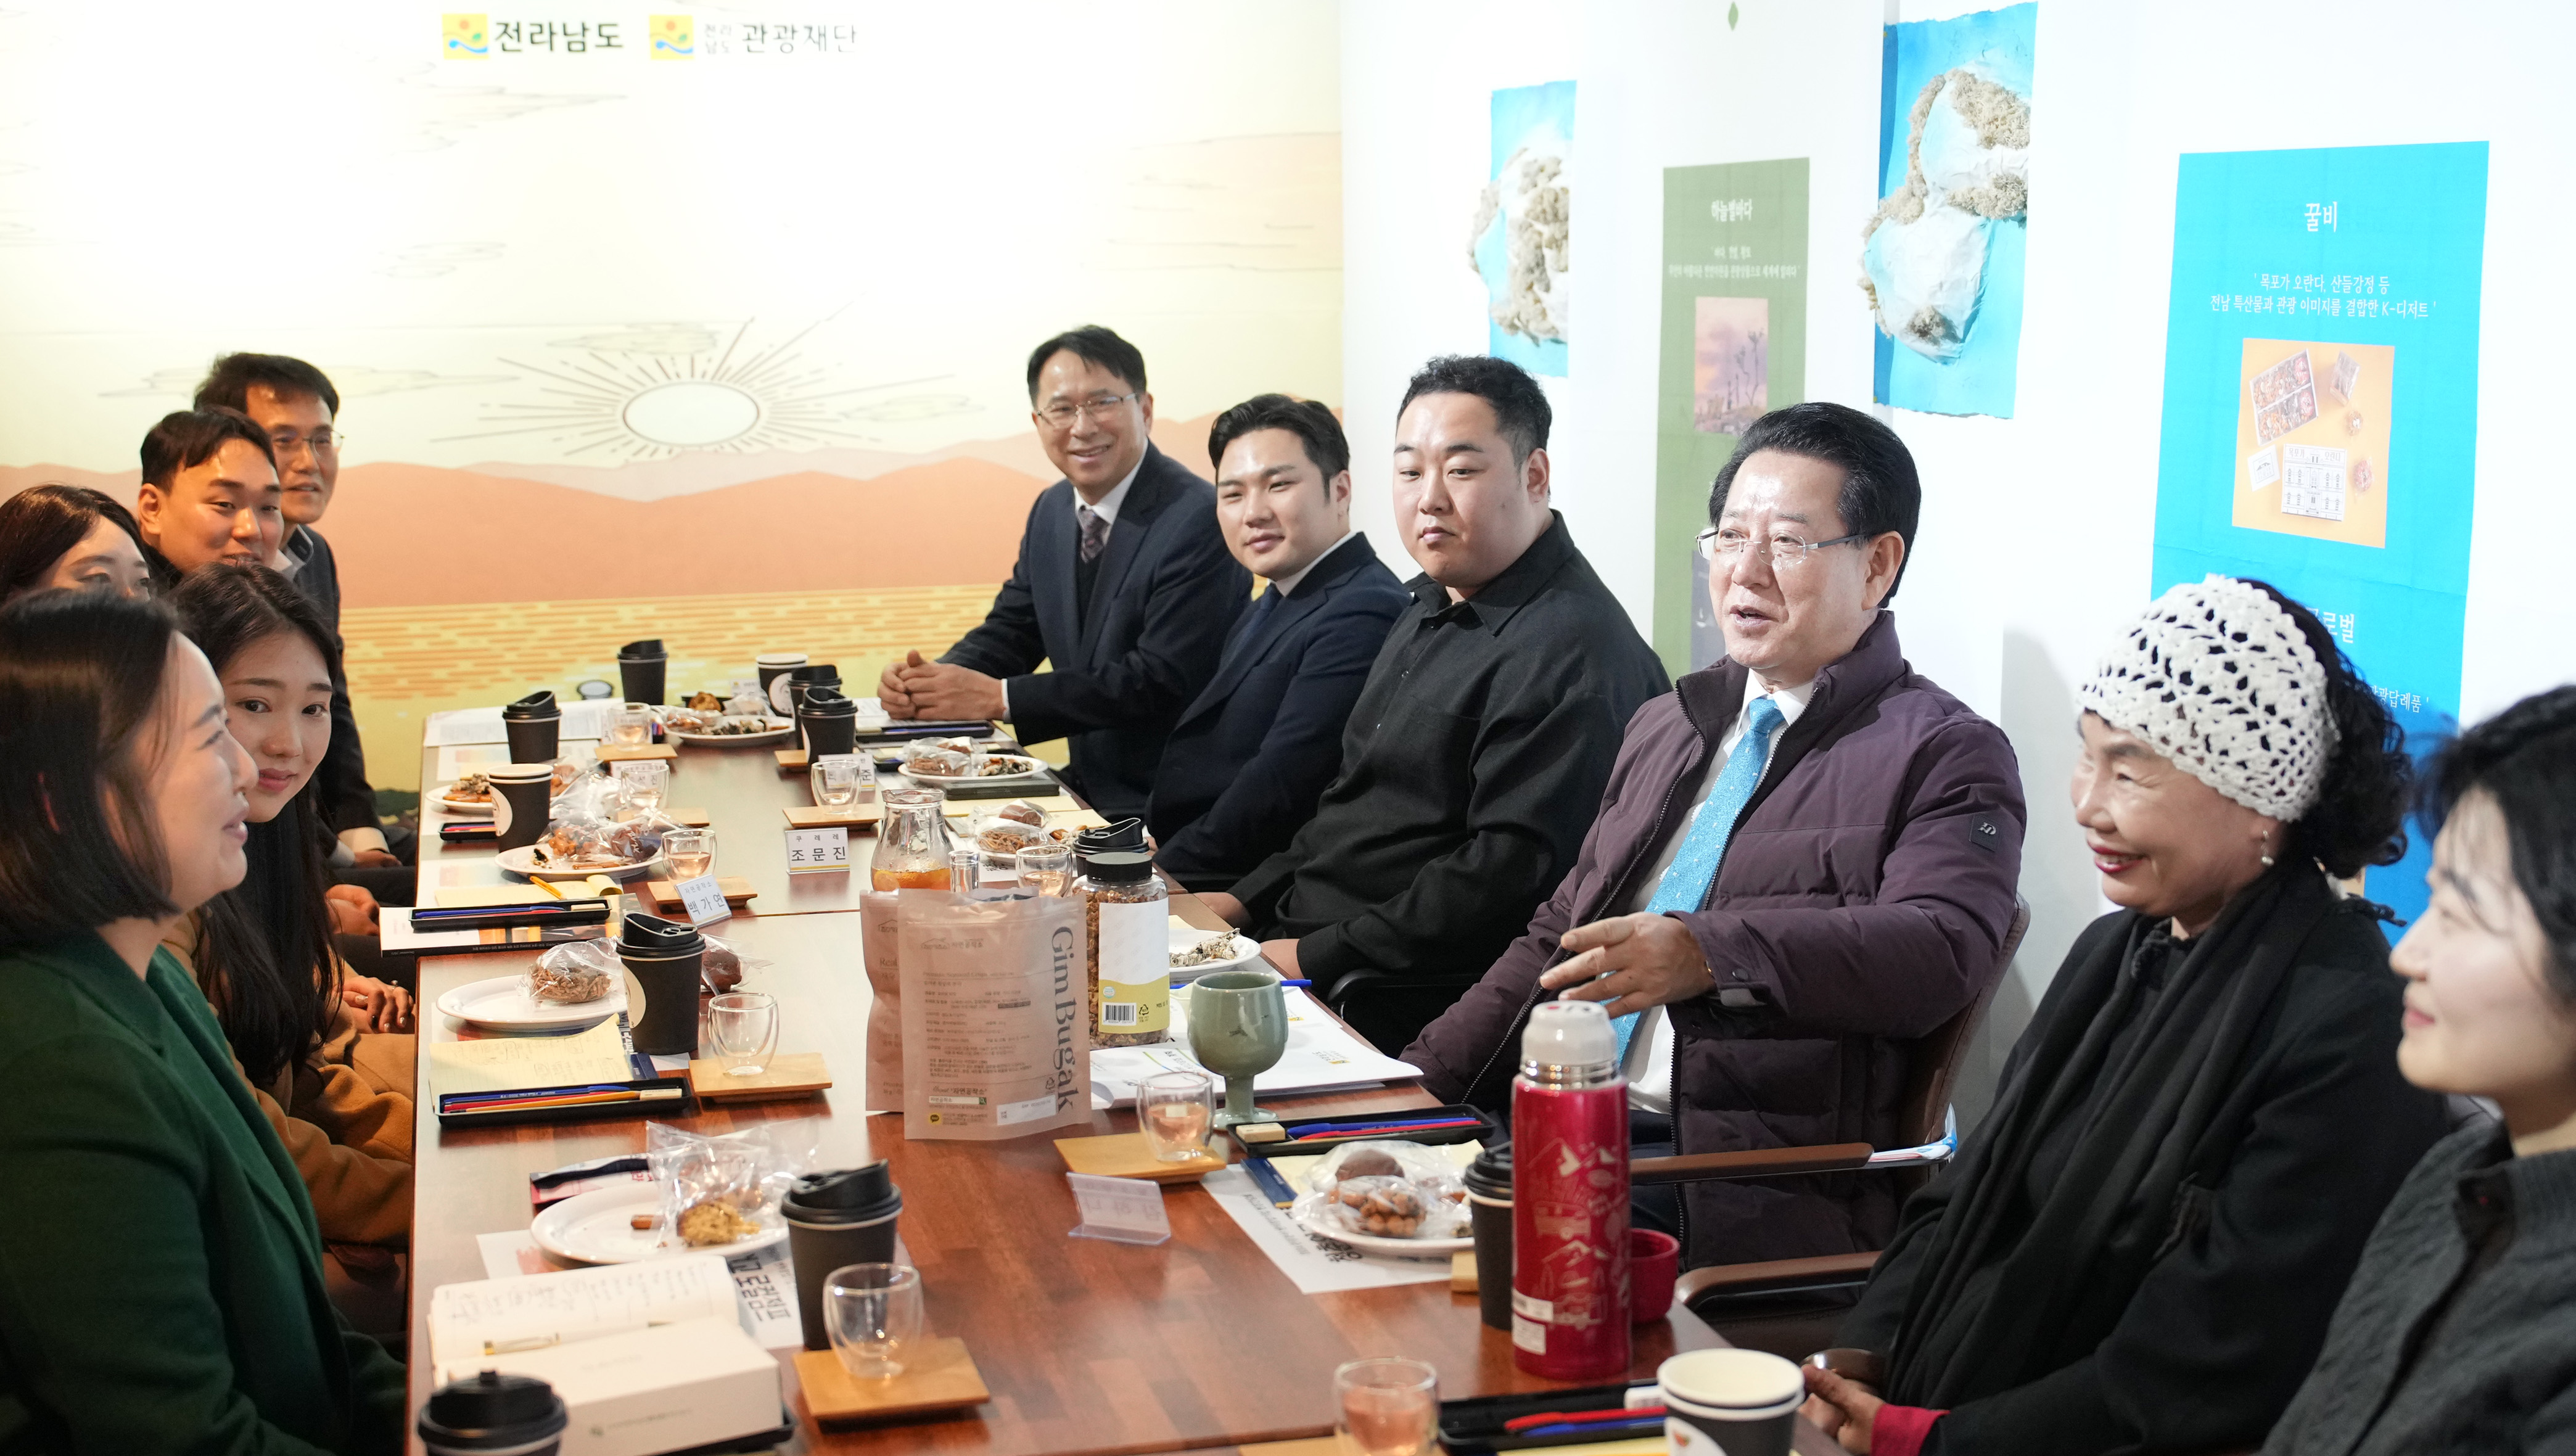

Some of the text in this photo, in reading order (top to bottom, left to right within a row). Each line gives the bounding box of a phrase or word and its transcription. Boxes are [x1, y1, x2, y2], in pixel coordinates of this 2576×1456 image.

[495, 21, 623, 52] 전라남도
[742, 23, 857, 54] 관광재단
[2304, 201, 2338, 233] 꿀비
[2260, 273, 2390, 295] 목포가 오란다, 산들강정 등
[2210, 294, 2429, 319] 전남 특산물과 관광 이미지를 결합한 K-디저트
[685, 881, 713, 894] 자연공작소
[1051, 926, 1079, 1113] Gim Bugak
